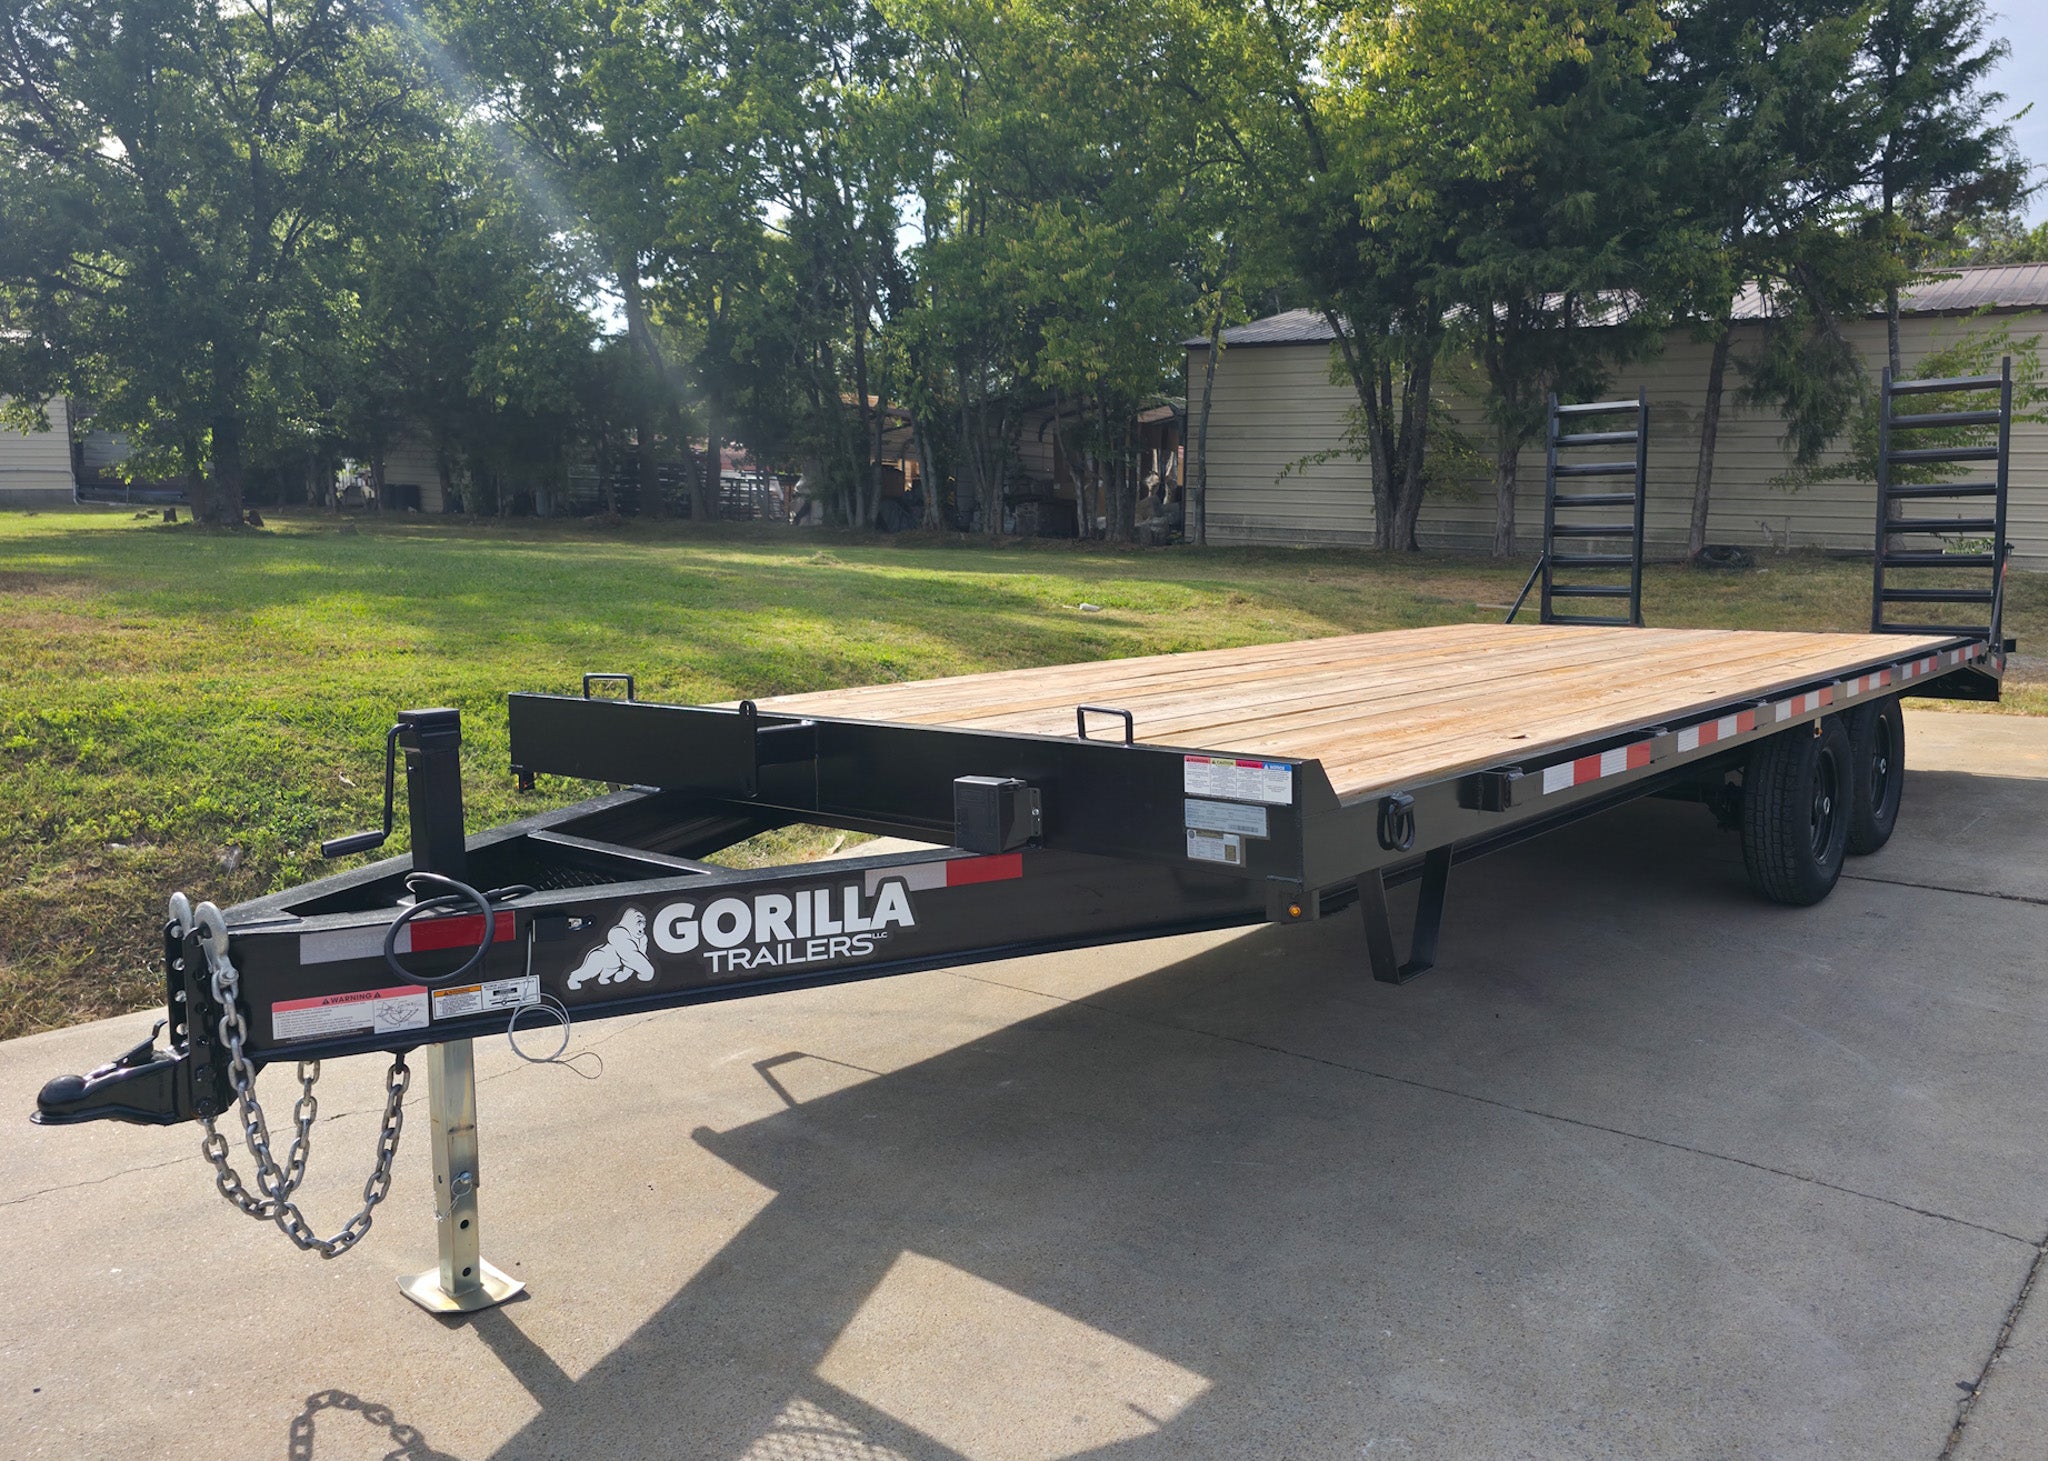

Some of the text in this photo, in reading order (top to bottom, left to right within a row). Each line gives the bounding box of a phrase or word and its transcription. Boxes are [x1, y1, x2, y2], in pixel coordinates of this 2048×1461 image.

[653, 881, 915, 954] GORILLA
[703, 931, 888, 973] TRAILERS LLC
[330, 991, 373, 1004] WARNING
